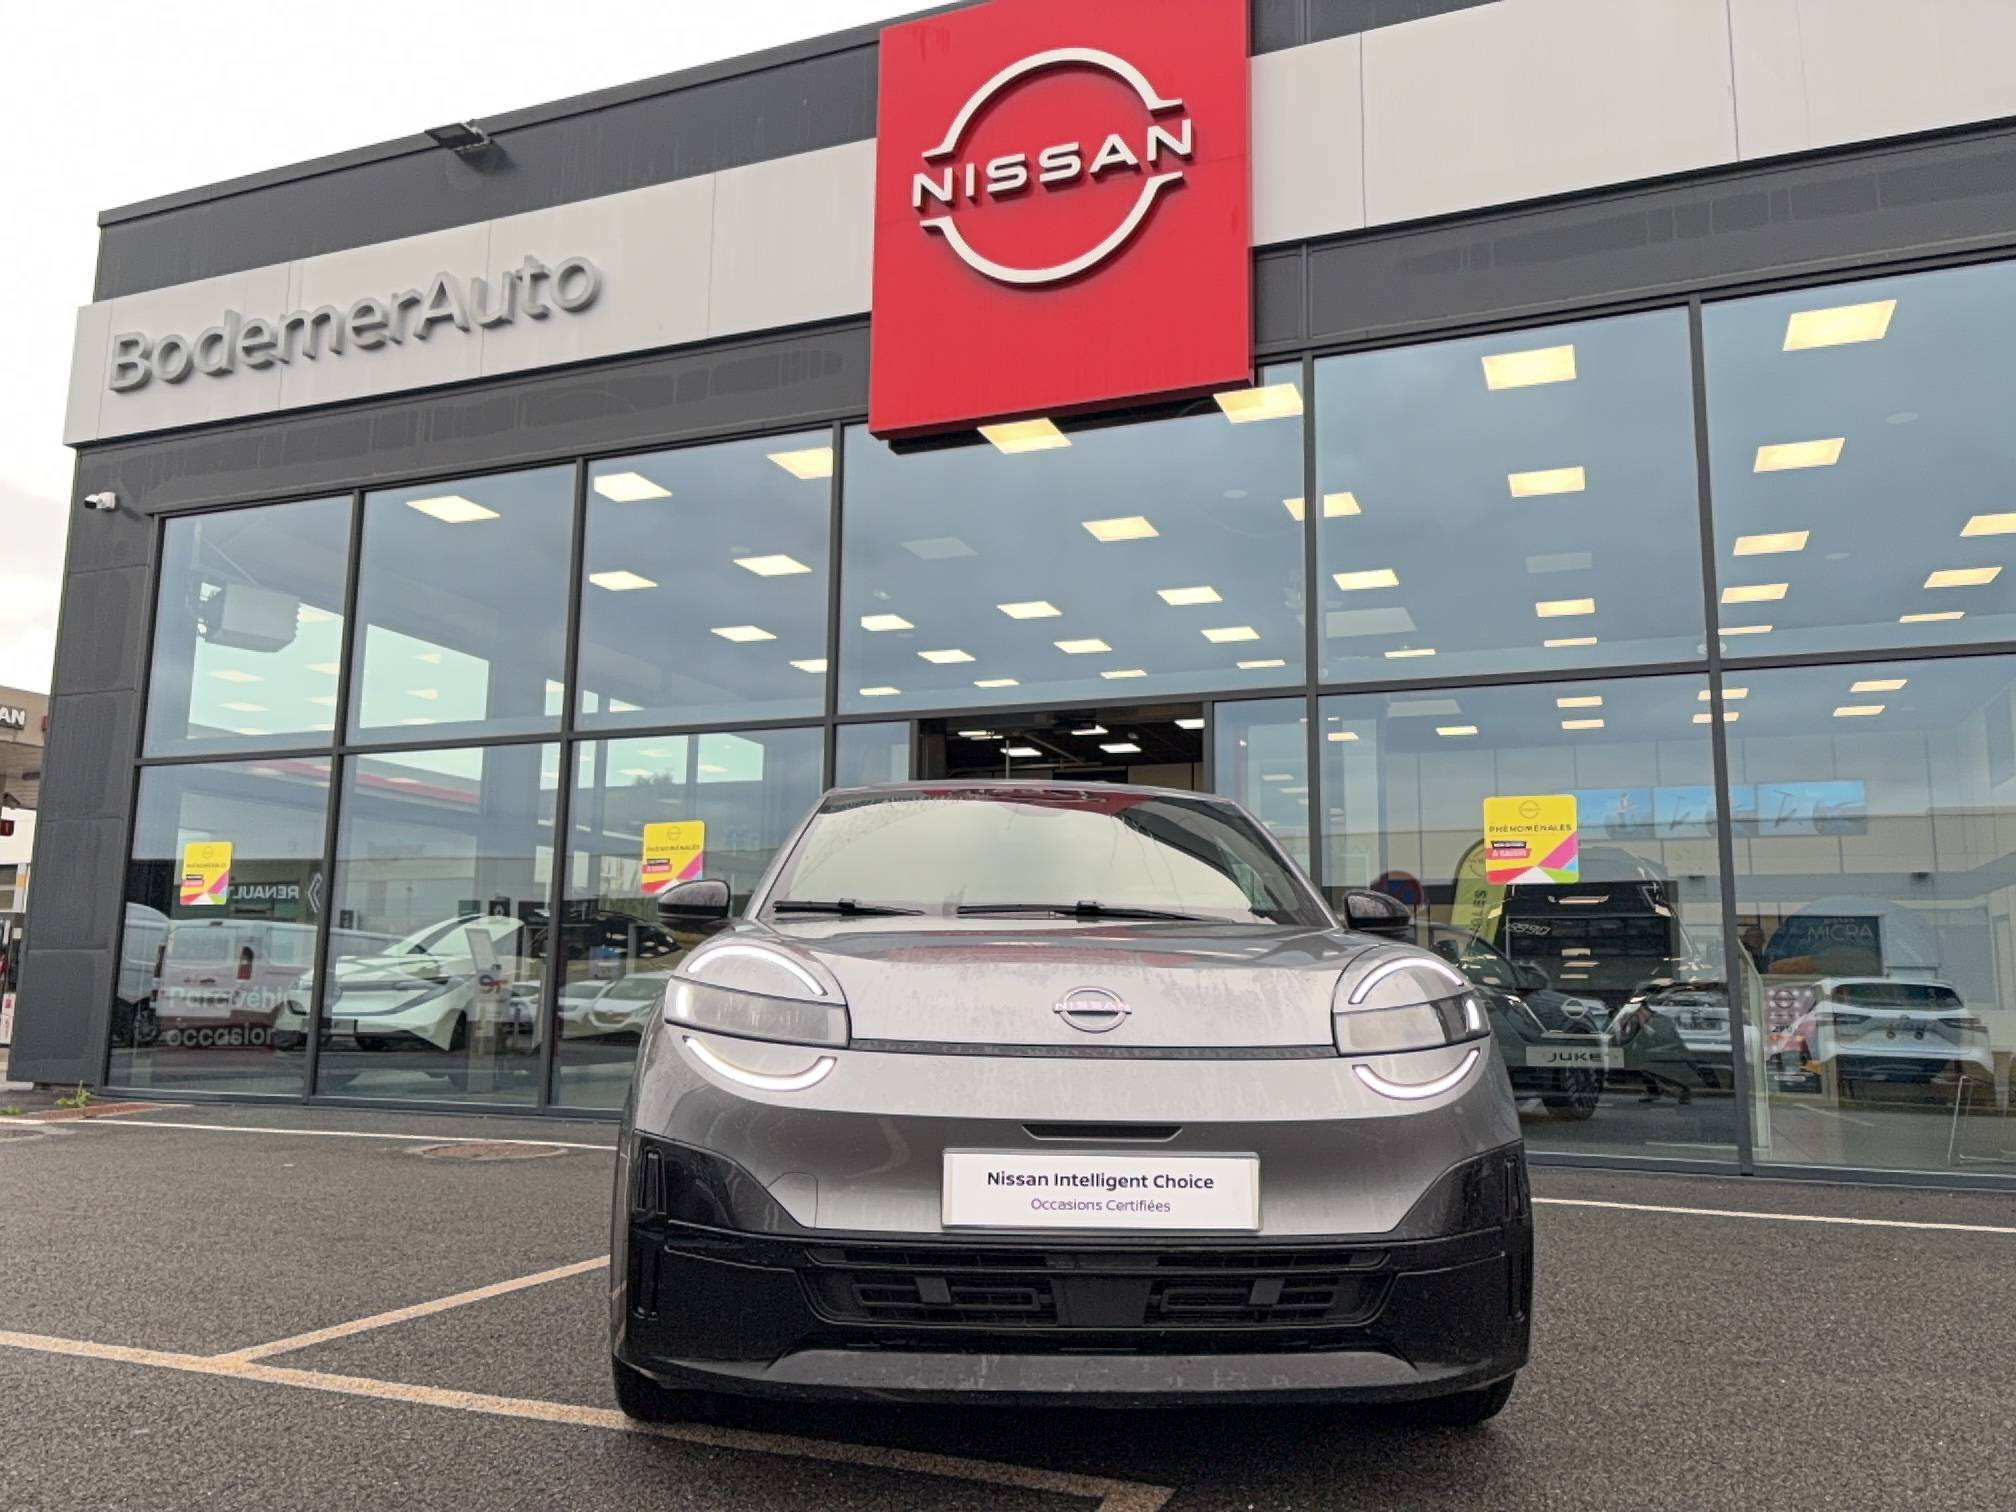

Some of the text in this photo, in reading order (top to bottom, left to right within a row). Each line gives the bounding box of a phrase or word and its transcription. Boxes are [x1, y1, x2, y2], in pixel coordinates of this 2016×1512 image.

[912, 119, 1193, 212] NISSAN
[108, 253, 600, 393] BodemerAuto
[1807, 924, 1874, 942] MICRA
[1546, 1052, 1605, 1063] JUKE
[986, 1171, 1214, 1191] Nissan Intelligent Choice
[1030, 1198, 1171, 1212] Occasions Certifiées
